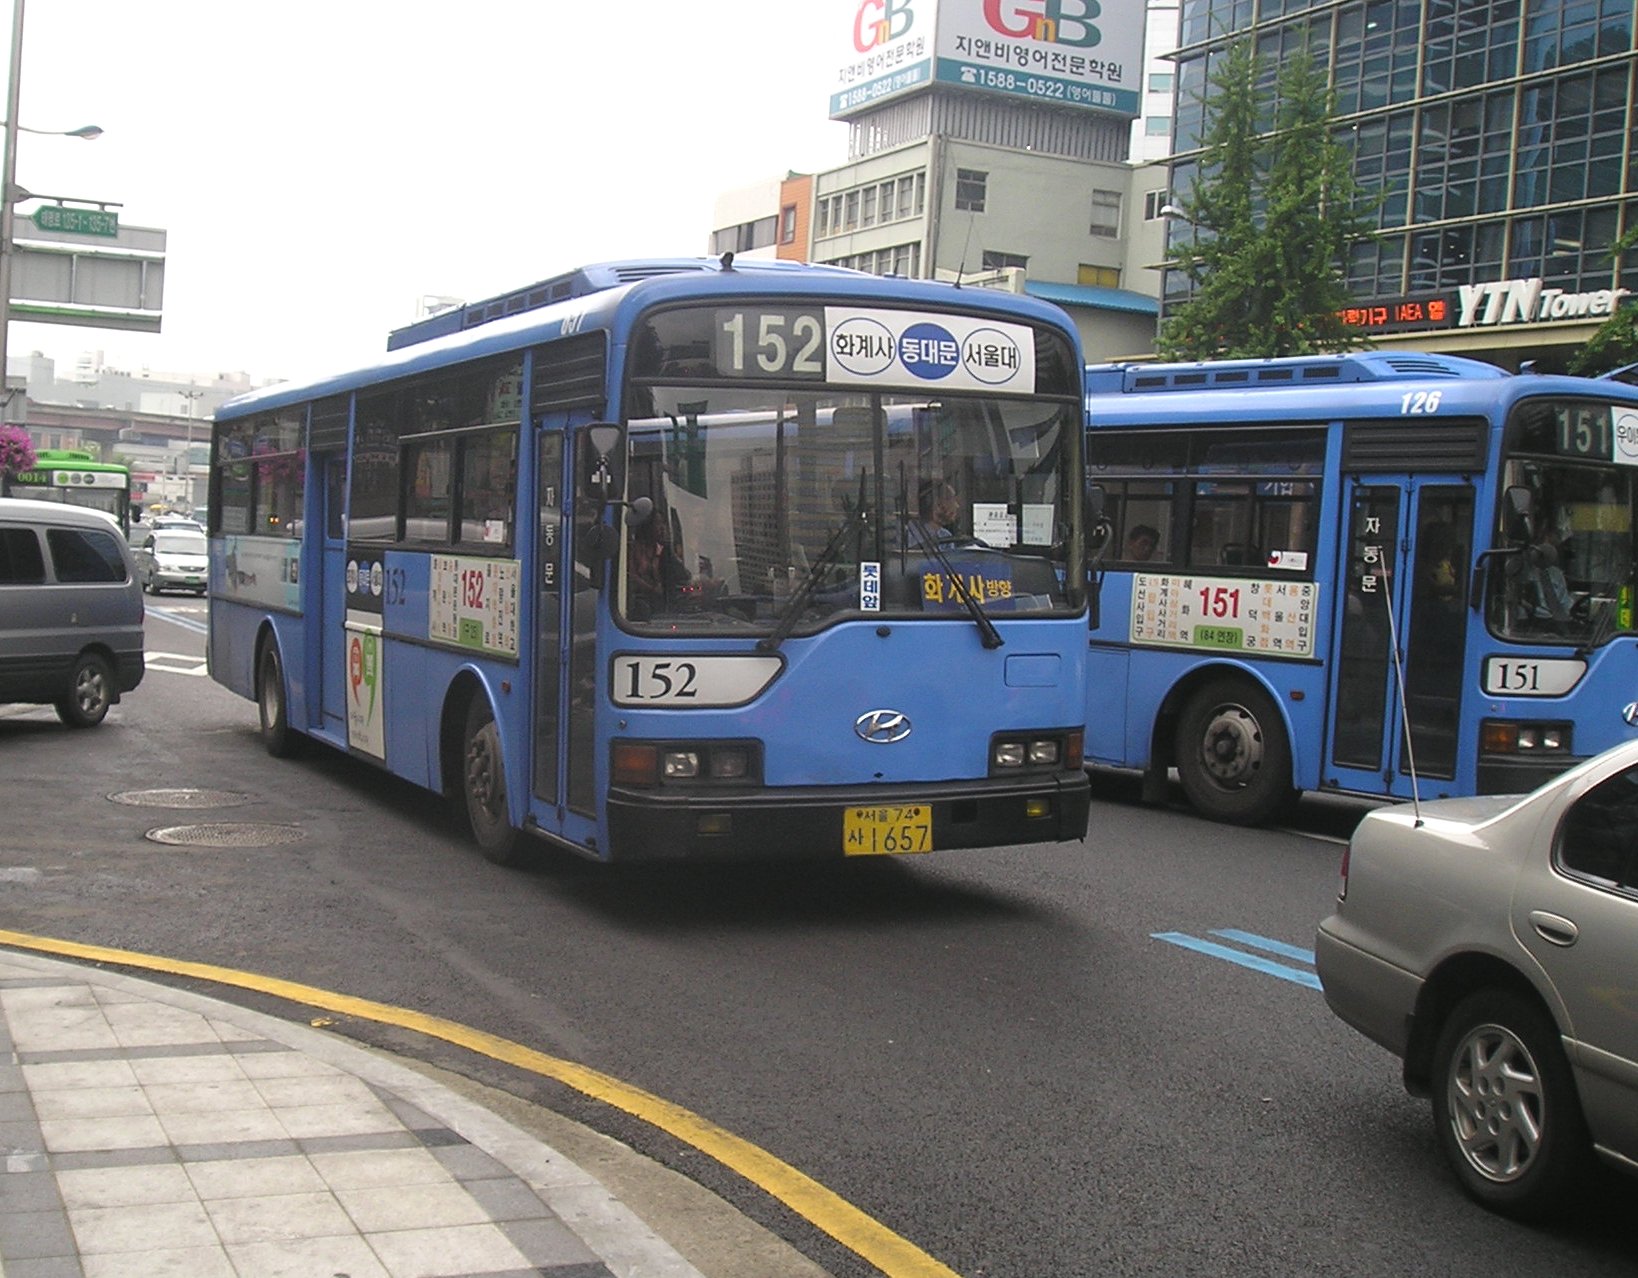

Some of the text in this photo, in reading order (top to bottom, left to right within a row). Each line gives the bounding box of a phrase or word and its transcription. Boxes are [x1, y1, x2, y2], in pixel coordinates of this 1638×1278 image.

[956, 35, 1123, 83] 지앤비영어전문학원
[979, 69, 1064, 99] 1588-0522
[1395, 304, 1423, 321] IAEA
[1459, 278, 1630, 327] YTN Tower
[722, 312, 823, 373] 152
[836, 333, 1018, 370] 화계사 동대문 서울대
[1401, 391, 1443, 414] 126
[1558, 407, 1610, 453] 151
[1617, 425, 1638, 445] 우이
[1361, 517, 1381, 593] 자동문
[386, 568, 406, 605] 152
[461, 570, 484, 609] 152
[863, 565, 878, 609] 롯데앞
[986, 579, 1012, 598] 방향
[1200, 587, 1240, 618] 151
[1246, 583, 1260, 648] 창덕궁
[1273, 584, 1287, 650] 서울역
[1297, 585, 1312, 652] 중앙대입구
[626, 662, 698, 699] 152
[1498, 663, 1541, 690] 151
[864, 807, 914, 822] 서울 74
[848, 825, 928, 852] 사 1657
